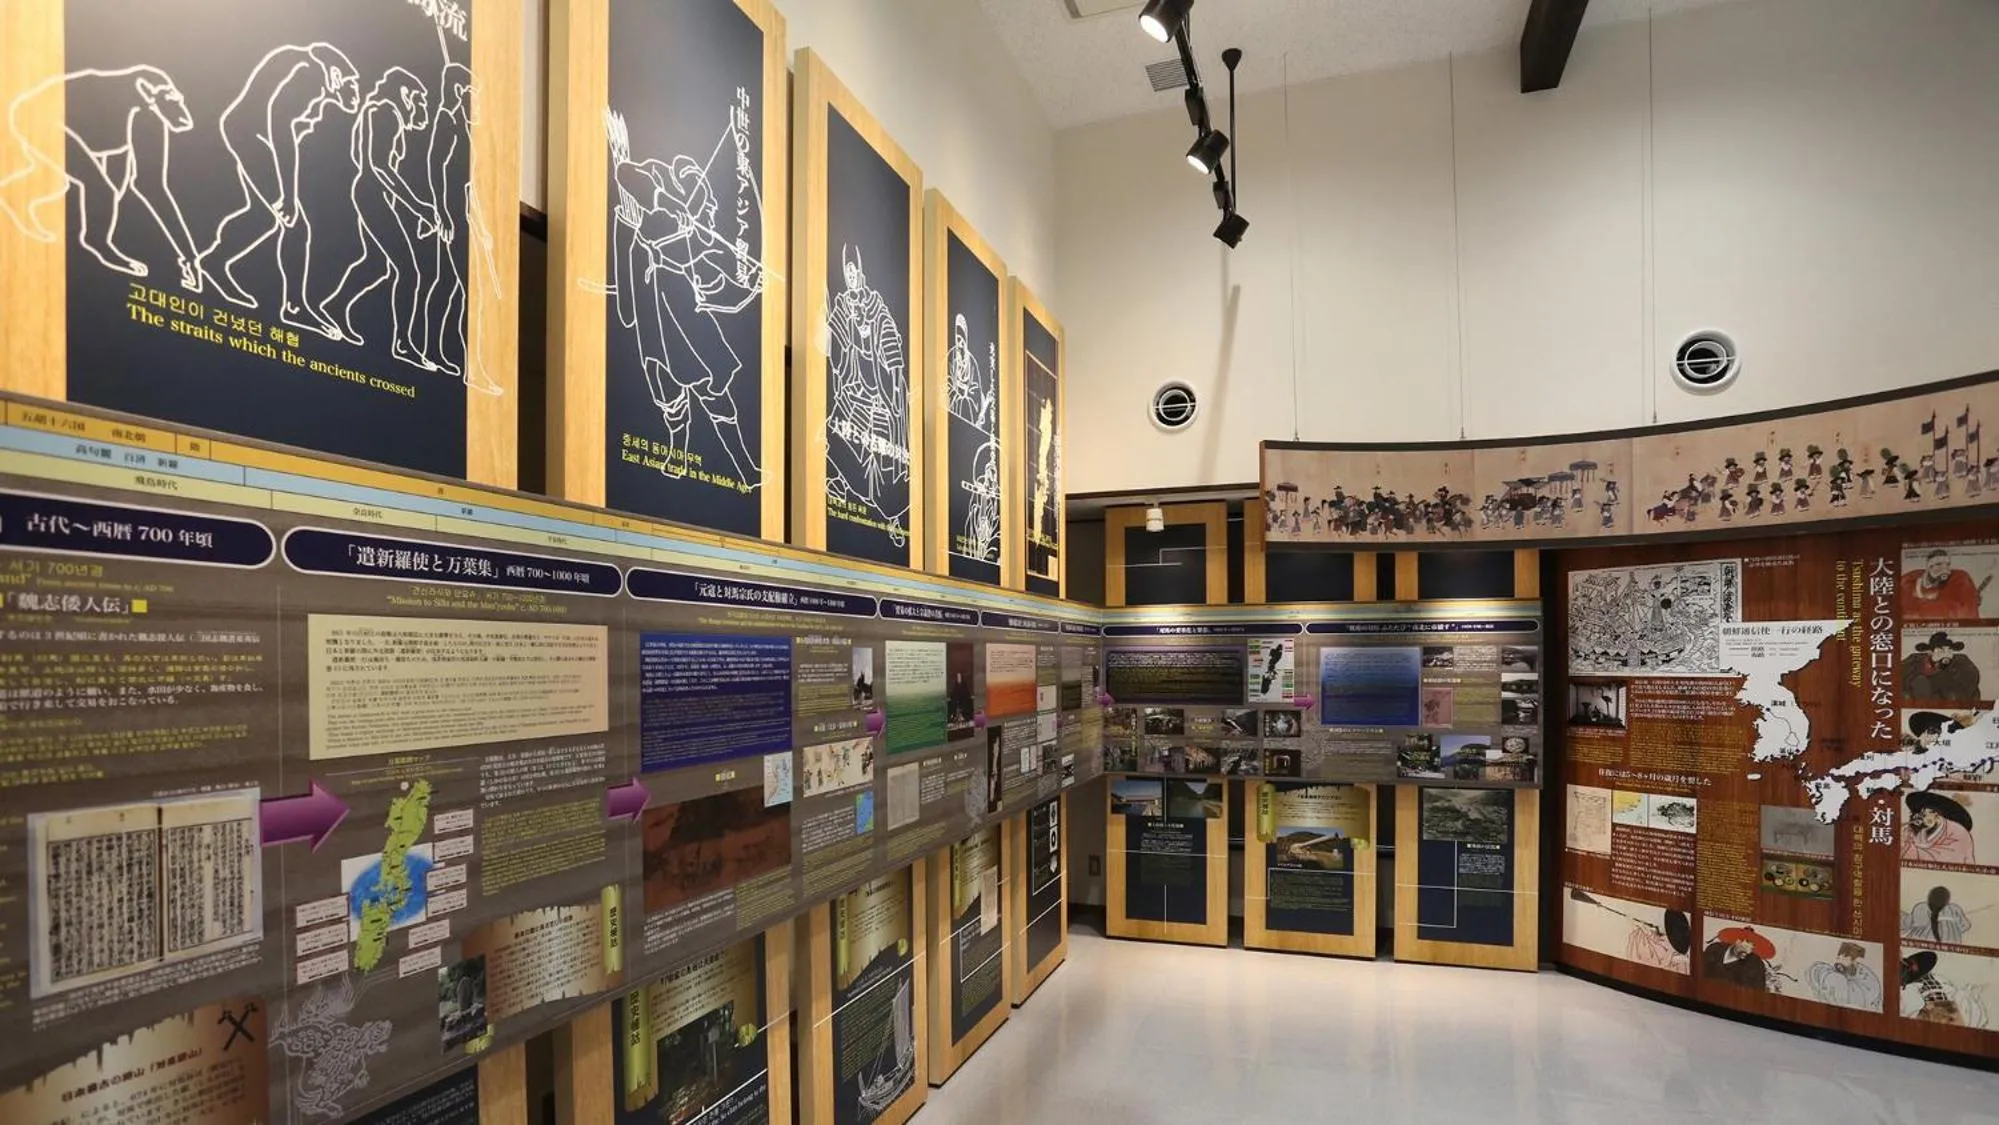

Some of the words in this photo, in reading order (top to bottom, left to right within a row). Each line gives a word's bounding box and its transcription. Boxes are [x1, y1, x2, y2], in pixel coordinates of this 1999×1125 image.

[129, 282, 204, 320] 고대인이
[213, 309, 263, 337] 건넜던
[270, 325, 300, 348] 해협
[127, 303, 165, 328] The
[170, 319, 224, 344] straits
[229, 334, 277, 359] which
[281, 349, 306, 368] the
[309, 358, 367, 385] ancients
[370, 376, 416, 399] crossed
[622, 449, 640, 464] East
[689, 468, 697, 479] in
[699, 471, 710, 482] the
[711, 473, 735, 489] Middle
[138, 526, 173, 543] 700
[348, 544, 499, 578] 「遣新羅使と万葉集」
[1852, 559, 1864, 609] Tsushima
[1852, 626, 1864, 642] the
[1849, 645, 1862, 688] gateway
